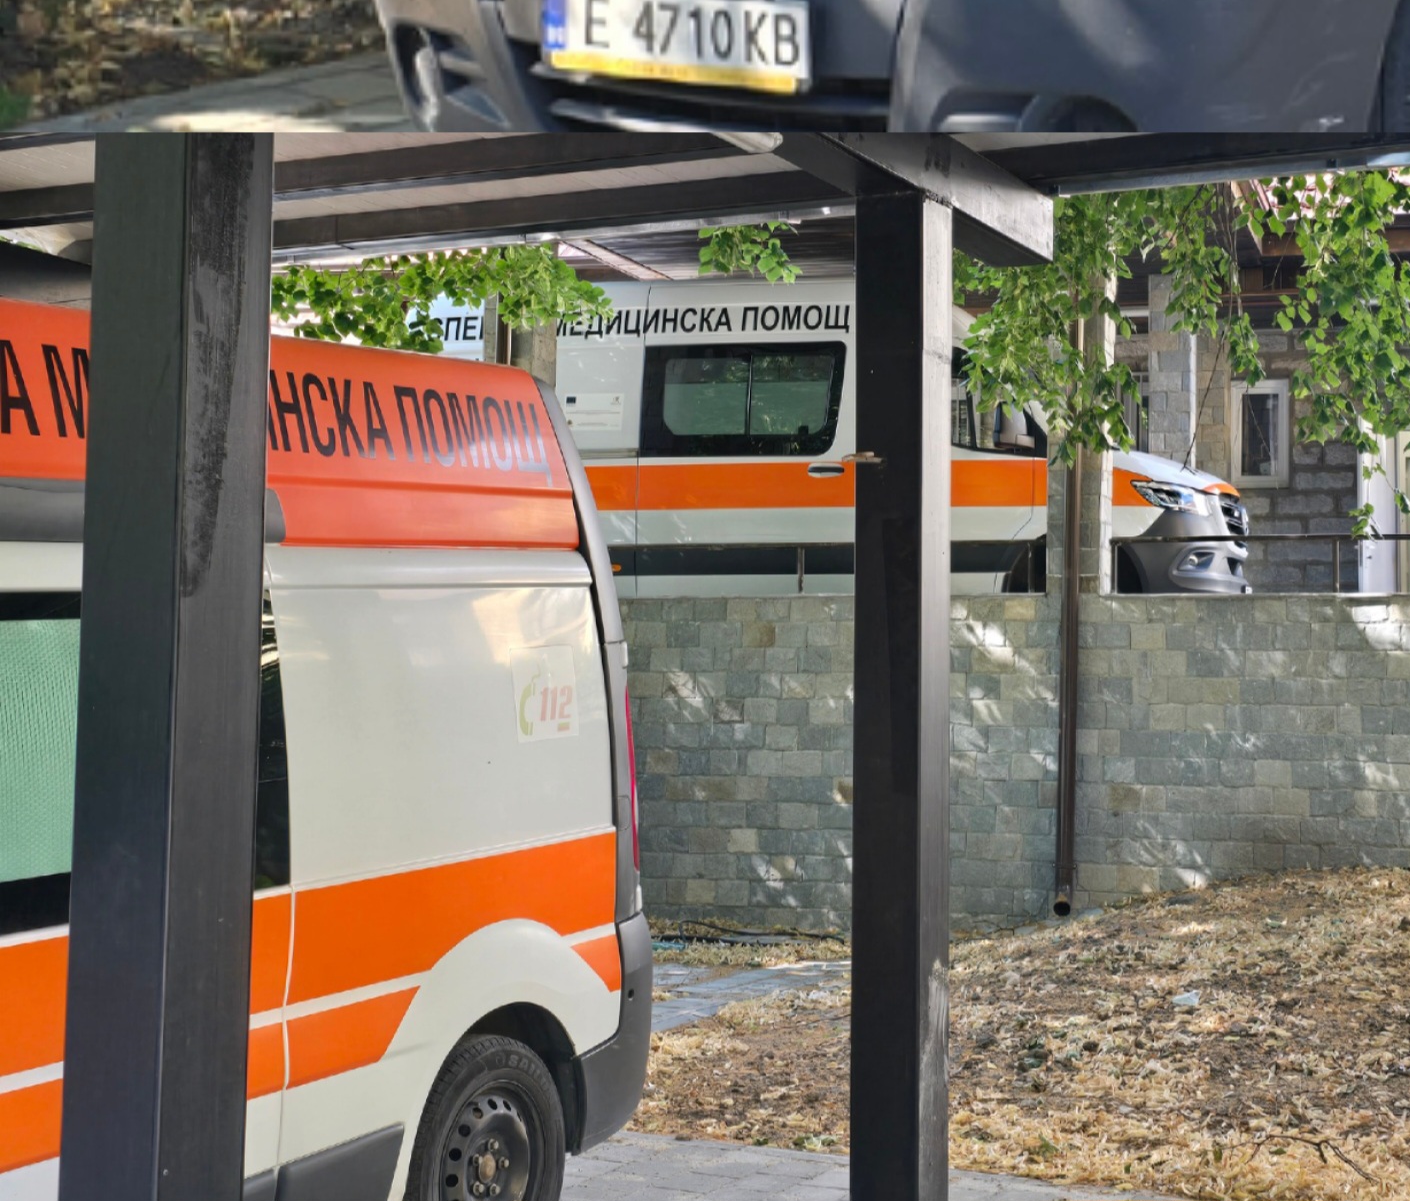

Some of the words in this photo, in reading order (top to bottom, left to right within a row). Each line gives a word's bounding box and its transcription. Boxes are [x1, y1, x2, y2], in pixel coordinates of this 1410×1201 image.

[741, 305, 851, 333] ПОМОЩ
[393, 384, 553, 488] ПОМОЩ
[540, 684, 573, 722] 112
